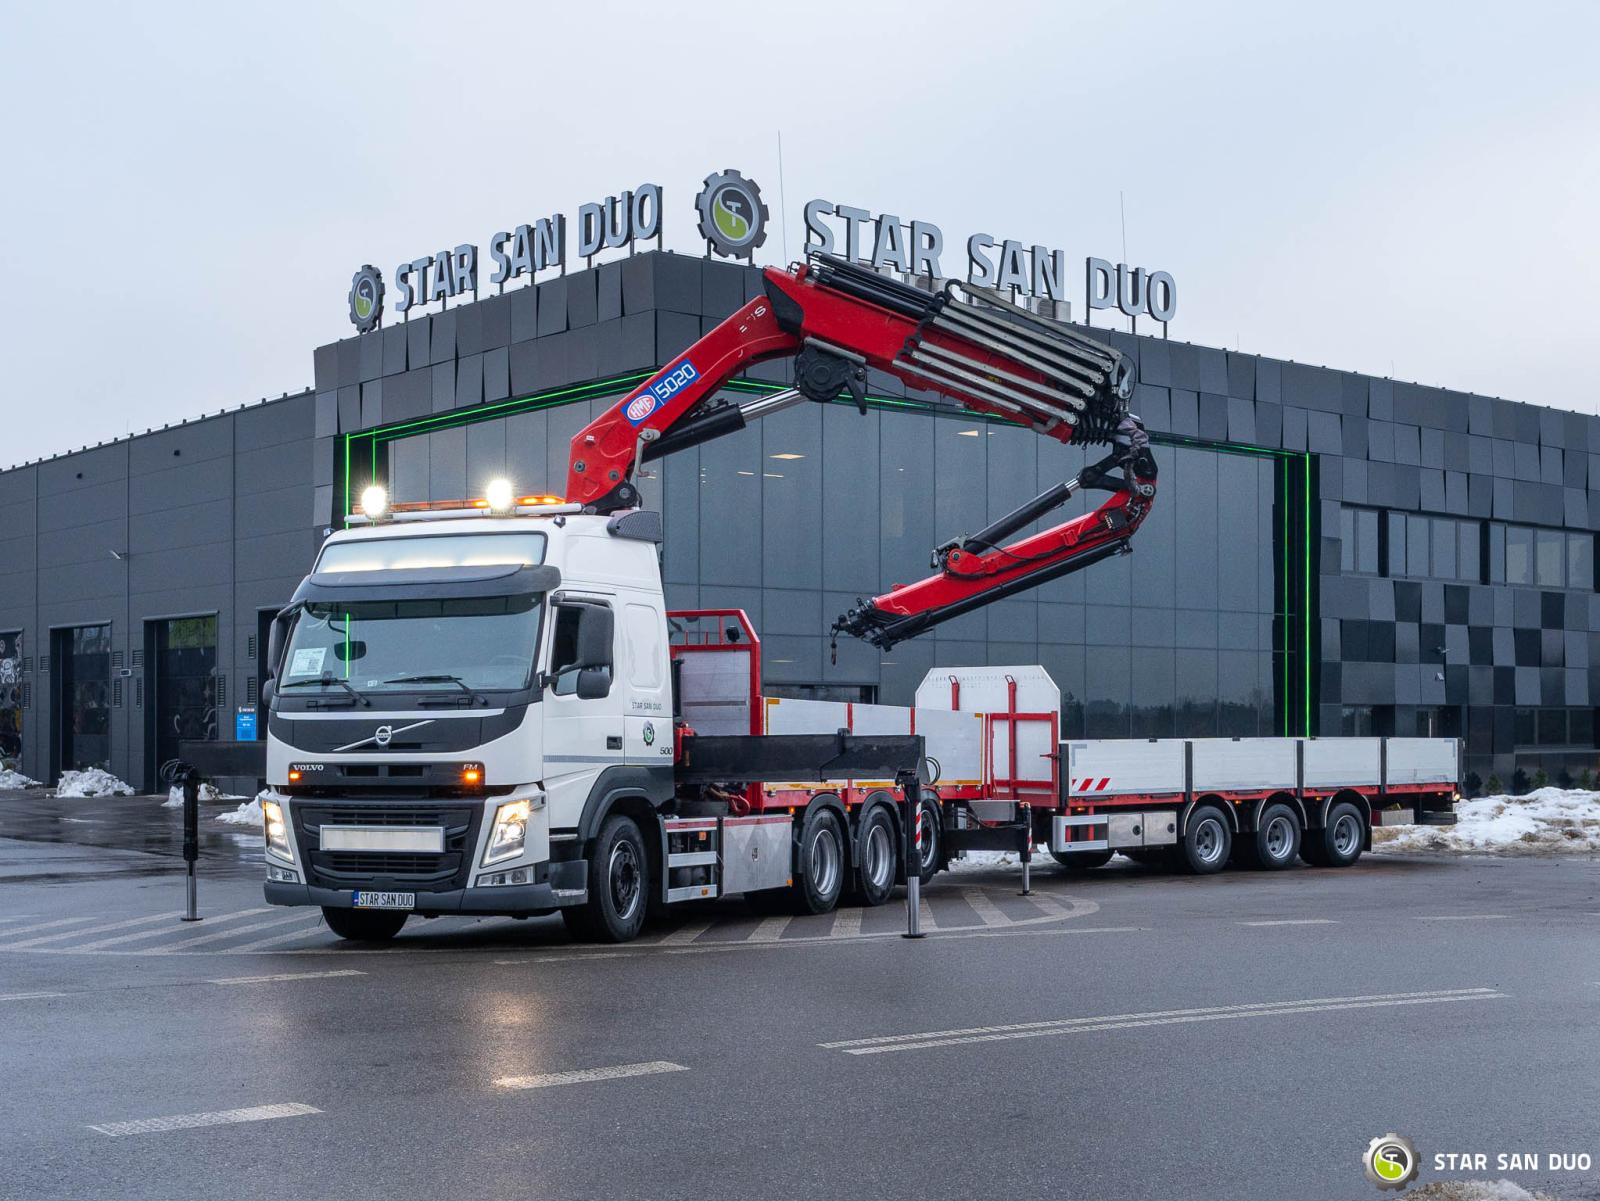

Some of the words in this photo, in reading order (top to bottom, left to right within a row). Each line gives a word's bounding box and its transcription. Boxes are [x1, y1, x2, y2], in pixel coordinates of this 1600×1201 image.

[395, 244, 478, 312] STAR
[490, 213, 566, 284] SAN
[579, 183, 662, 258] DUO
[804, 199, 943, 280] STAR
[967, 232, 1065, 301] SAN
[1086, 256, 1177, 322] DUO
[655, 363, 696, 399] 5020
[629, 396, 654, 418] HMF
[632, 701, 643, 710] STAR
[644, 702, 653, 710] SAN
[660, 746, 673, 755] 500
[463, 763, 478, 771] FM
[360, 892, 379, 906] STAR
[381, 893, 397, 906] SAN
[398, 894, 413, 906] DUO
